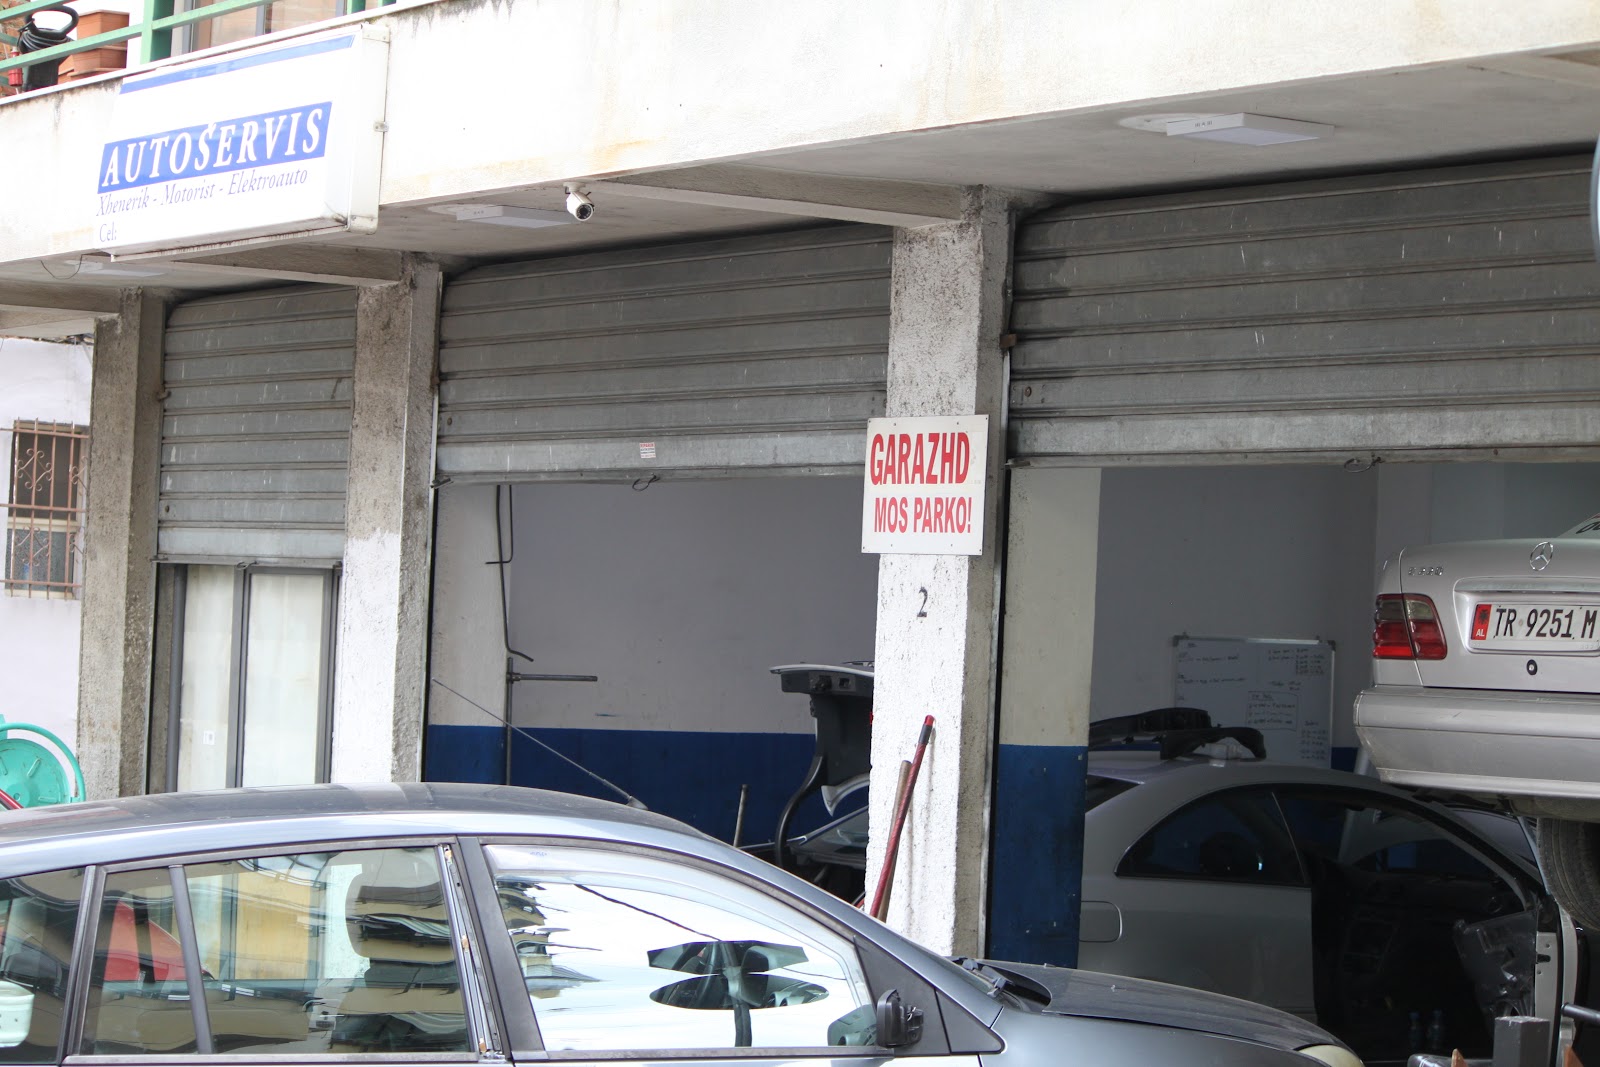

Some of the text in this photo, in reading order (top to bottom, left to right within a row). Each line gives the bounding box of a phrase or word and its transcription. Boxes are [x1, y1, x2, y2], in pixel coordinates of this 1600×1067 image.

[101, 108, 323, 187] AUTOSERVIS
[96, 188, 149, 217] Xhenerik
[160, 182, 215, 206] Motorist
[228, 167, 308, 197] Elektroauto
[99, 222, 117, 242] Cel:
[870, 432, 970, 486] GARAZHD
[874, 497, 972, 533] MOS PARKO!
[917, 587, 928, 617] 2
[1476, 628, 1485, 637] AL
[1494, 608, 1598, 639] TR 9251 M
